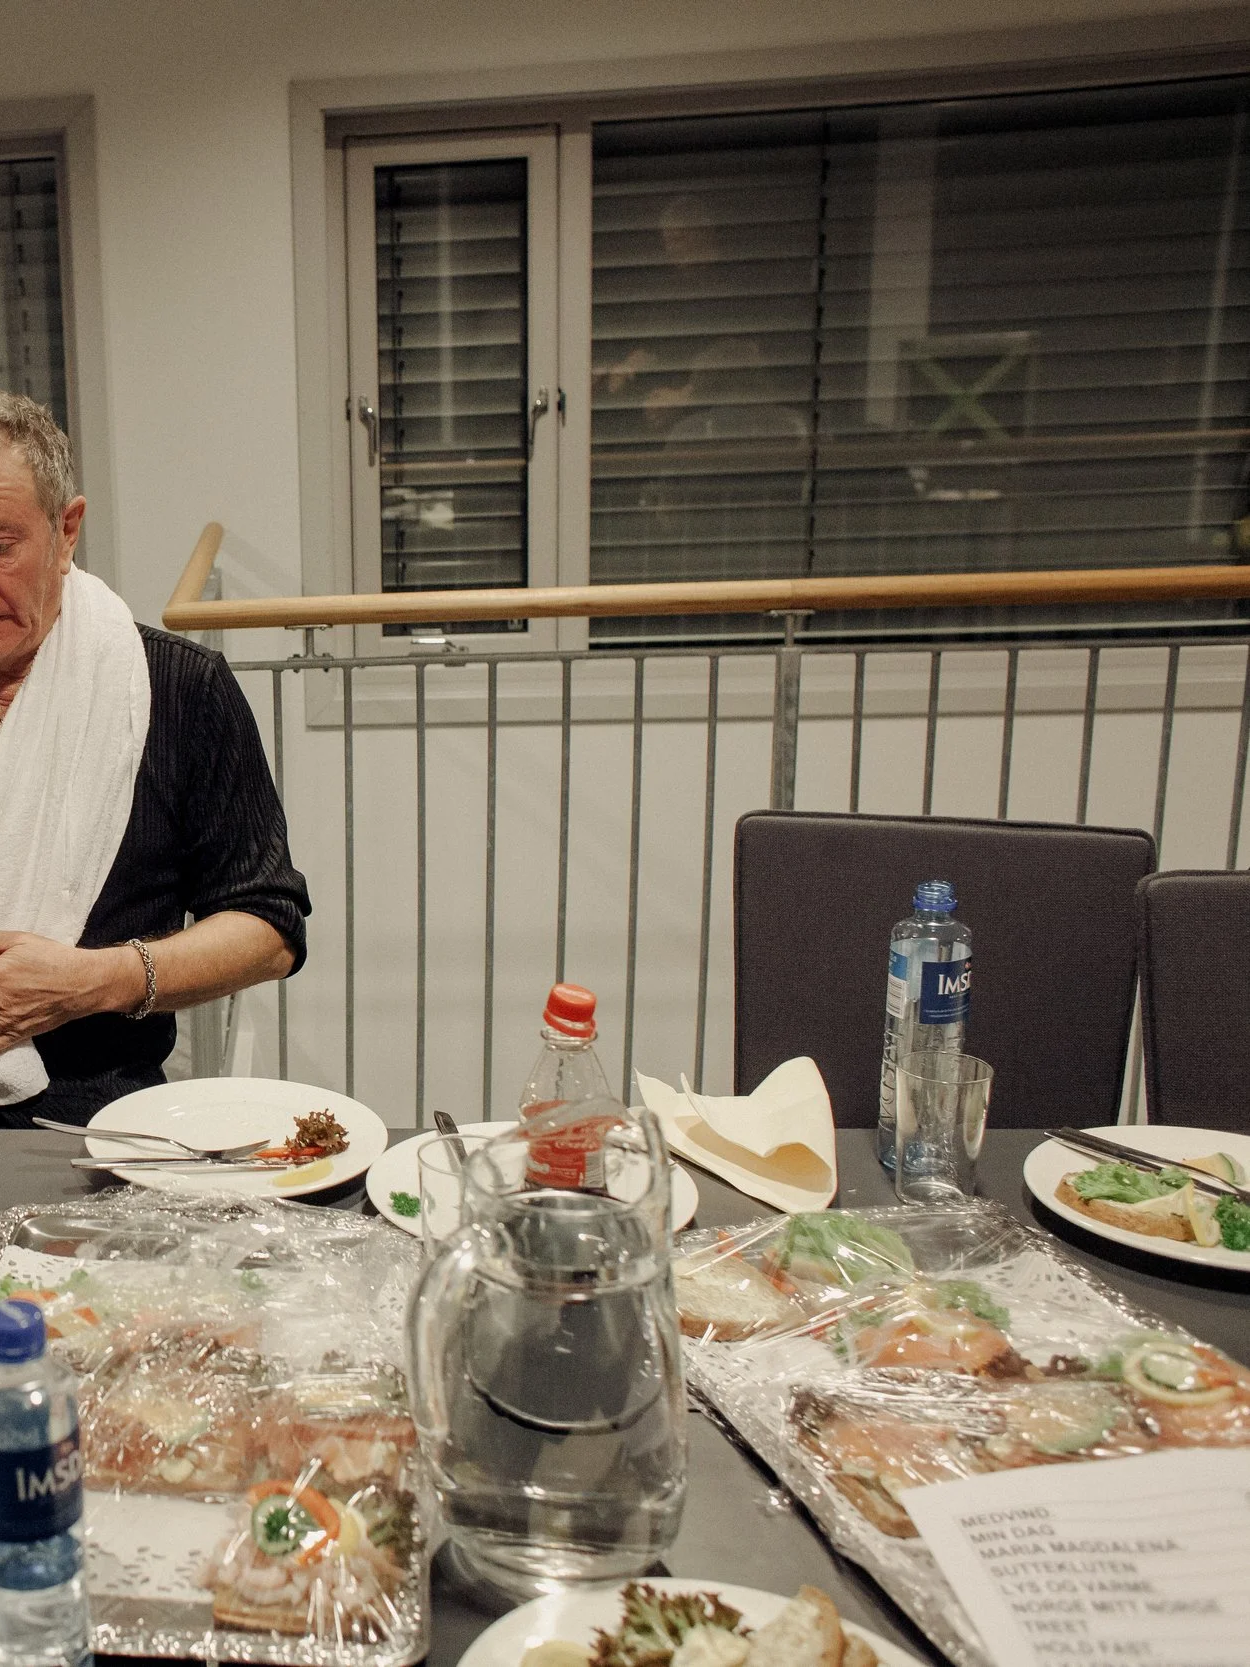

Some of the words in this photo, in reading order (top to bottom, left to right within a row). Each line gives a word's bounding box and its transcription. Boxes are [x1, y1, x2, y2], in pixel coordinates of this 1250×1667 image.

[959, 1506, 1051, 1528] MEDVIND
[969, 1530, 1007, 1544] MIN
[1010, 1523, 1055, 1539] DAG
[978, 1543, 1047, 1559] MARIA
